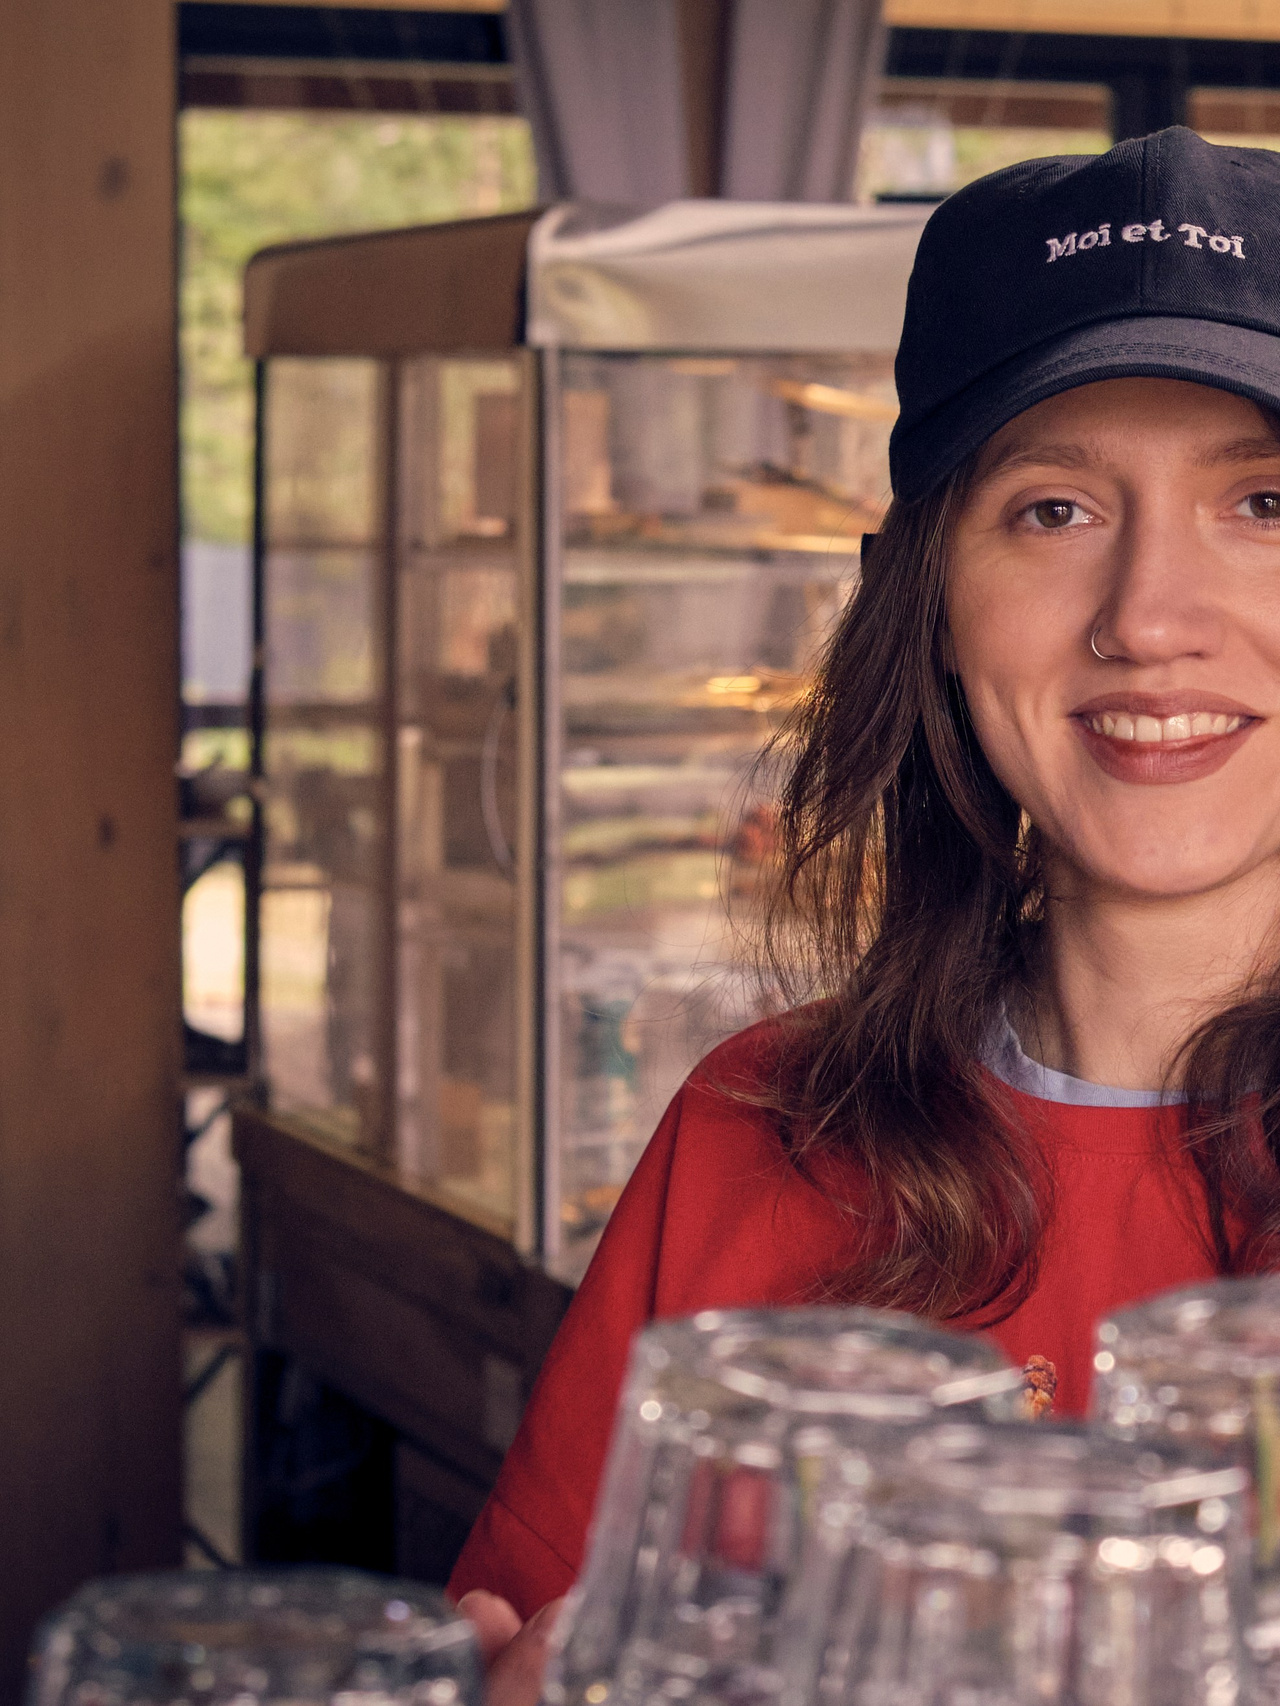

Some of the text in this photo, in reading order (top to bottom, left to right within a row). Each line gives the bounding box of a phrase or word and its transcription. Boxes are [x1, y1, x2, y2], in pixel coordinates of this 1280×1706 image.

[1045, 219, 1246, 263] Moi et Toi
